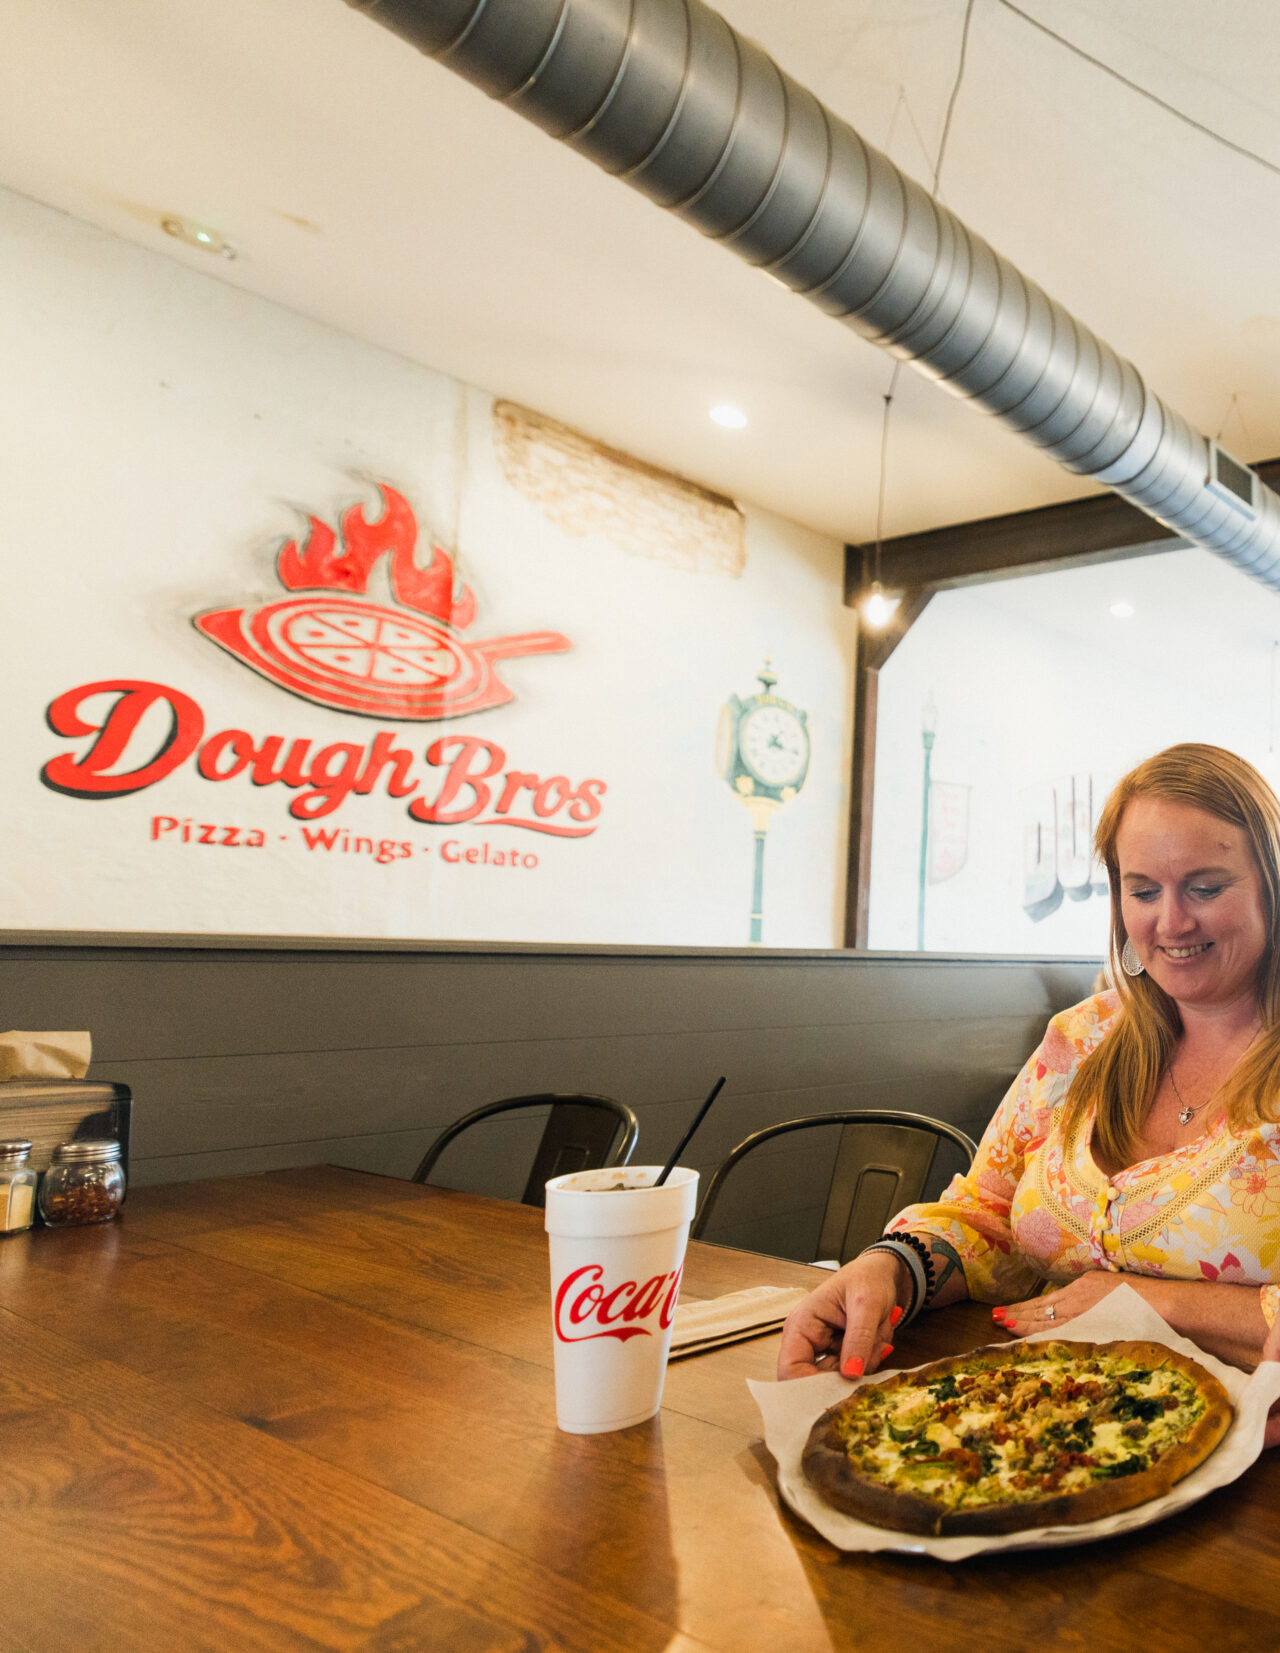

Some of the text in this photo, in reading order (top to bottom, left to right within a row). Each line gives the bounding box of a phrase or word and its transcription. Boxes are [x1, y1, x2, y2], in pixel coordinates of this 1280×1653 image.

[40, 678, 608, 838] Dough Bros
[150, 815, 540, 870] Pizza Wings Gelato
